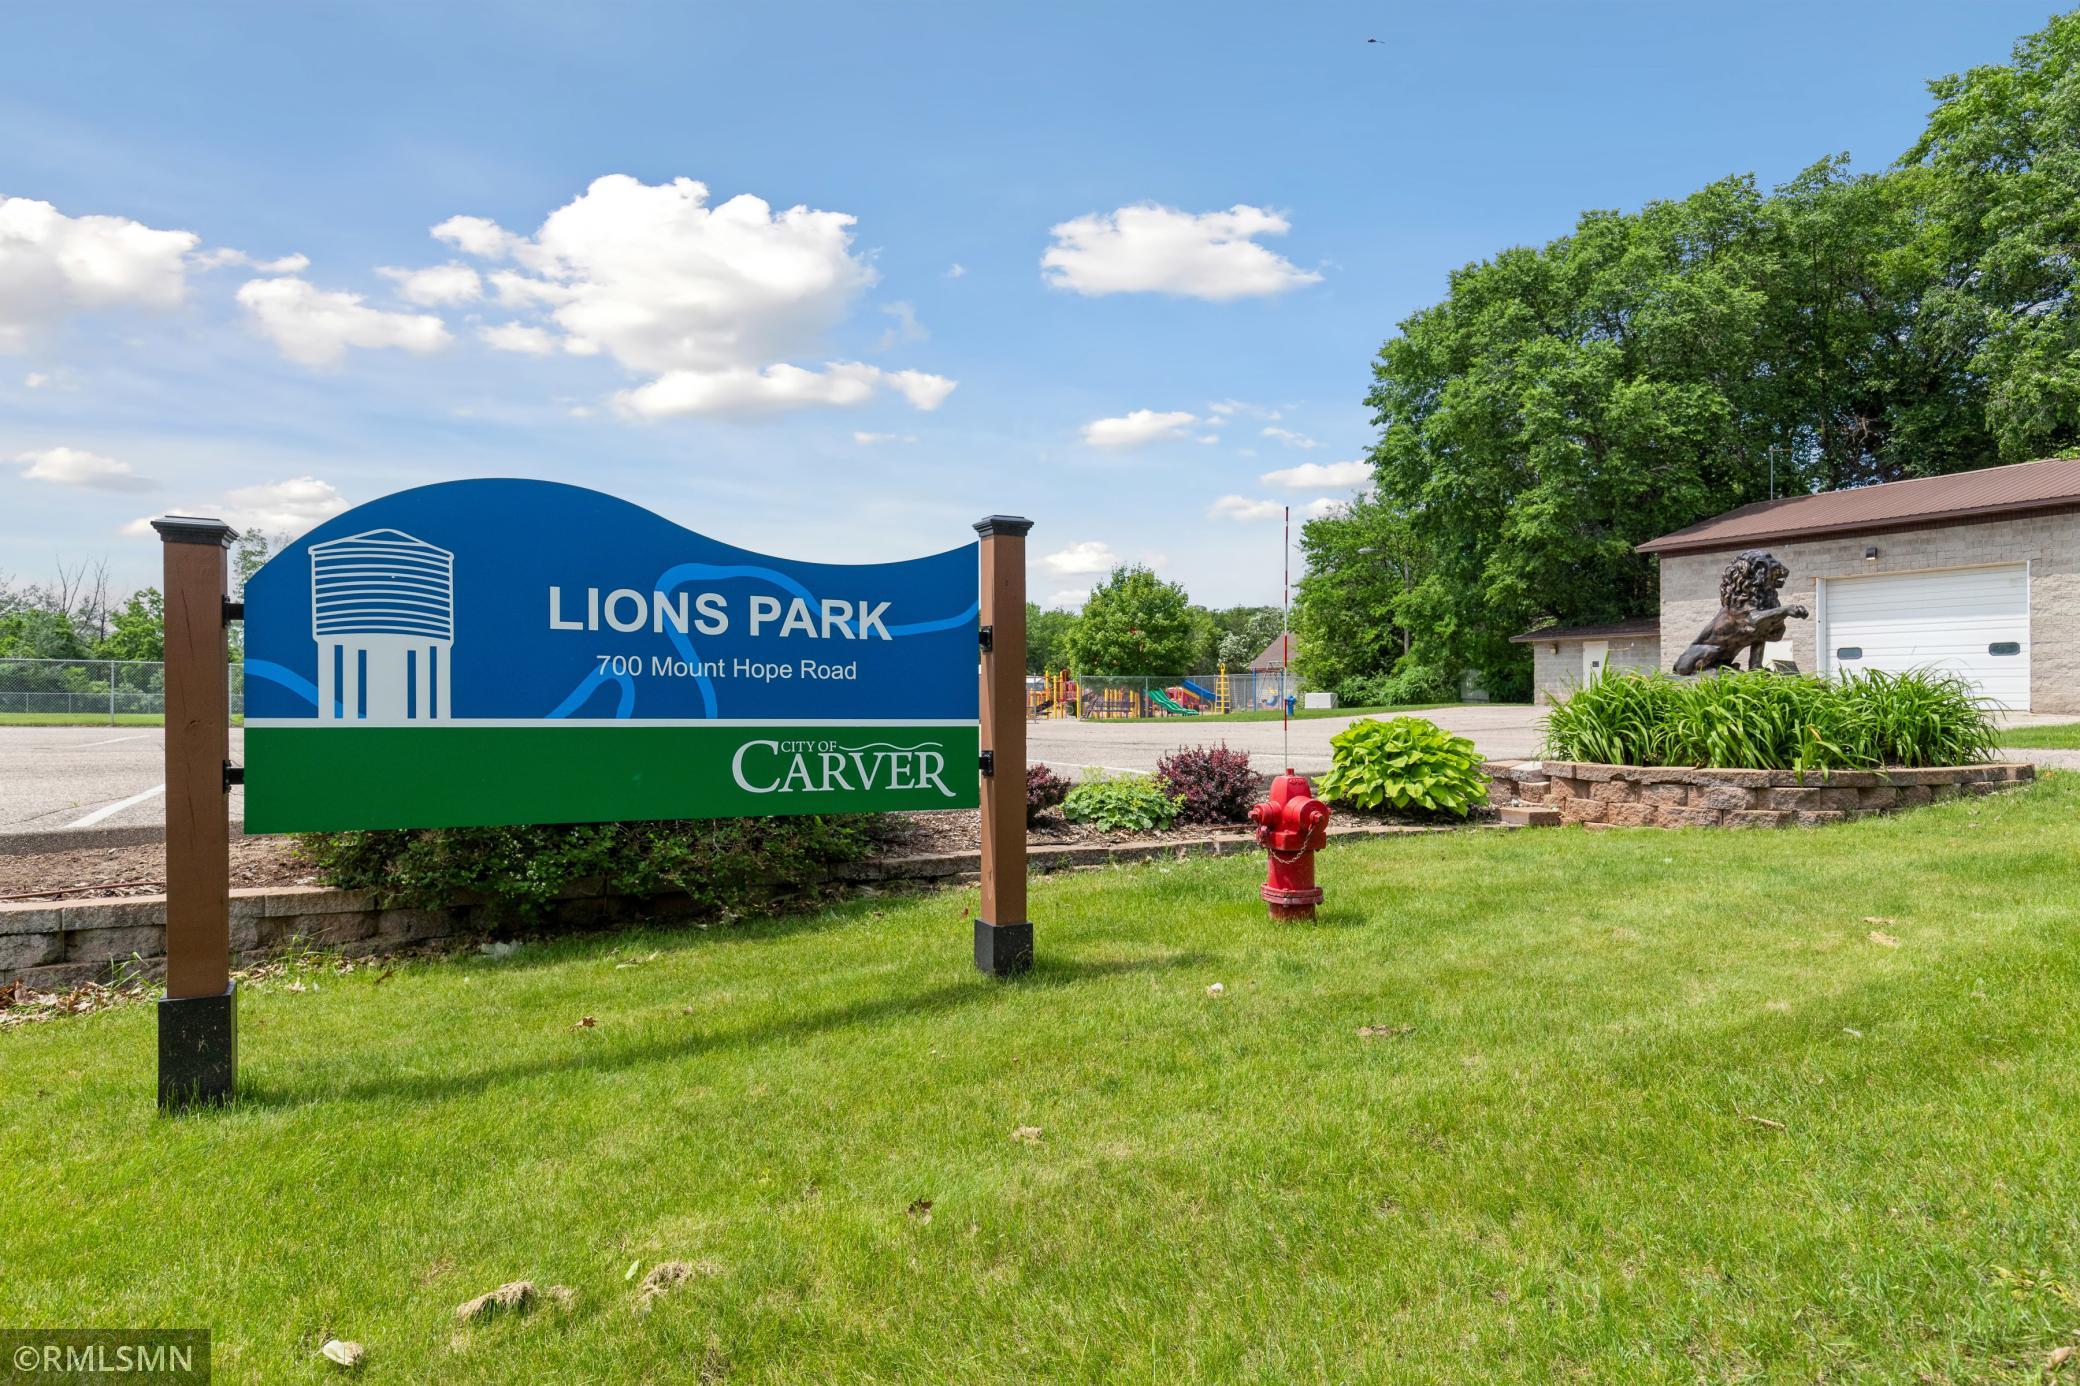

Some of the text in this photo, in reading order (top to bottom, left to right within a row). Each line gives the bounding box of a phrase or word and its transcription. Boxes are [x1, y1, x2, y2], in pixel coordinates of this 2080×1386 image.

[549, 586, 893, 641] LIONS PARK
[596, 655, 858, 683] 700 Mount Hope Road
[781, 741, 837, 752] CITY OF
[732, 739, 957, 797] CARVER
